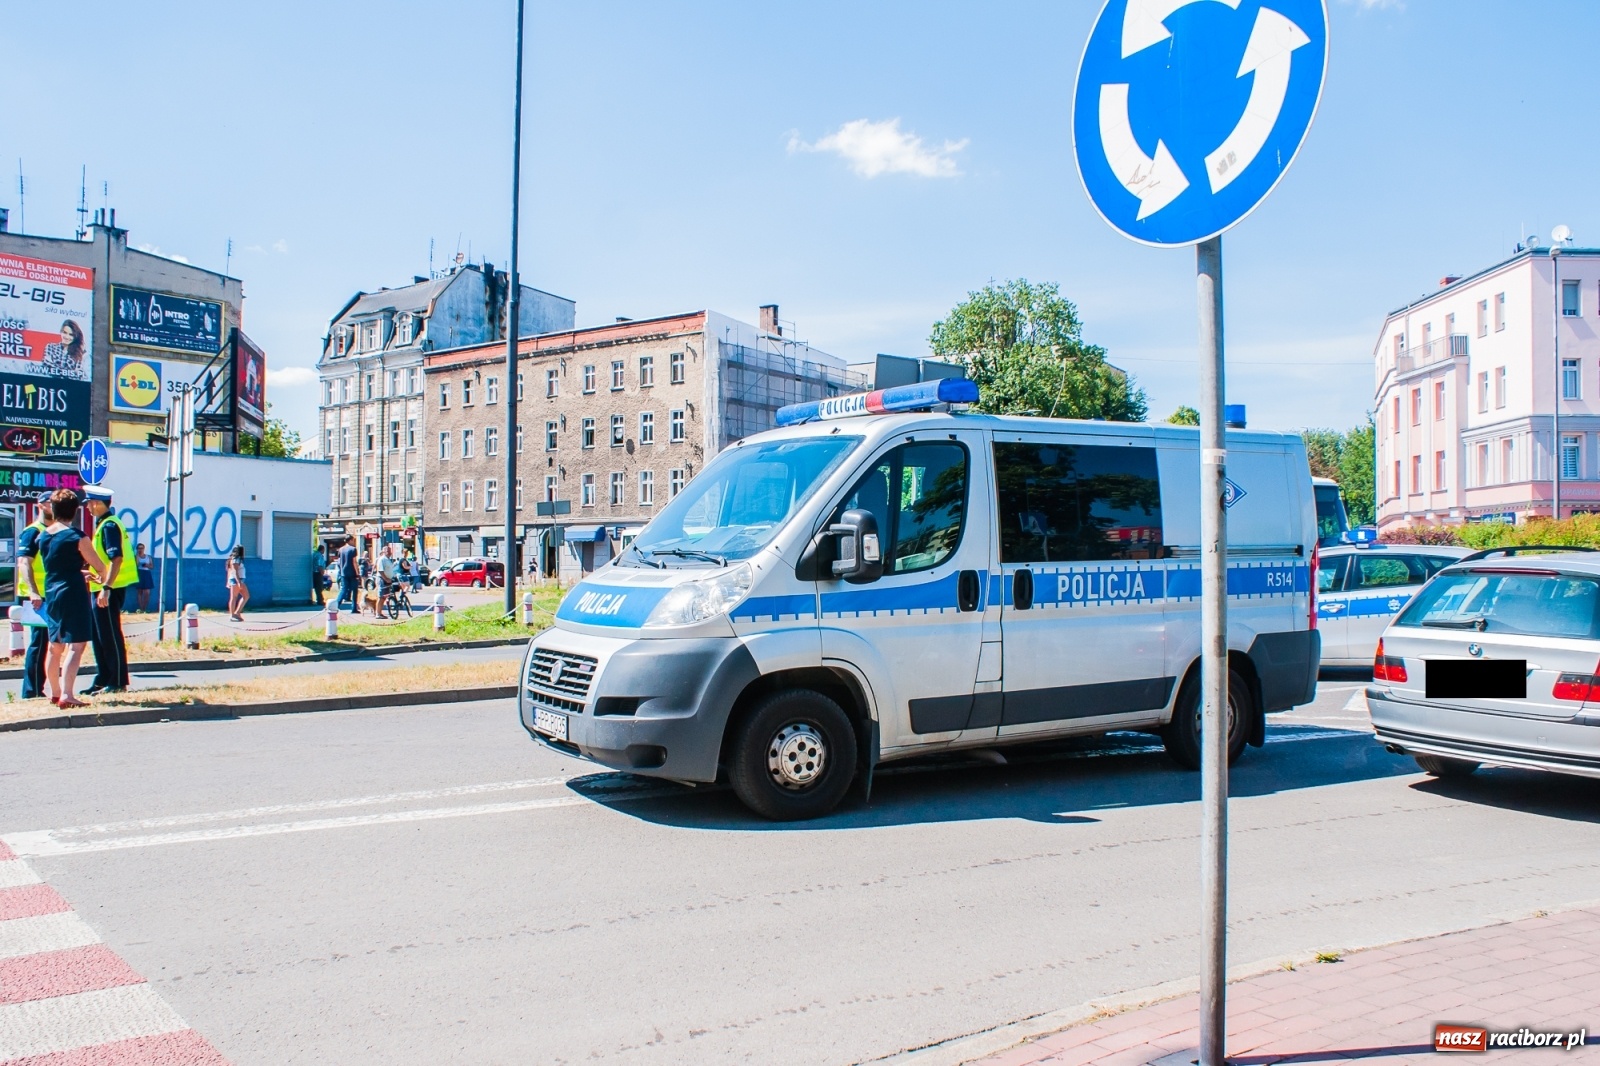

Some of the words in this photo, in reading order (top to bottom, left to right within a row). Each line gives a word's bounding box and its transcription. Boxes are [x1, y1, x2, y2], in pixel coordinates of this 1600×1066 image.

[26, 262, 87, 279] ELEKTRYCZNA
[29, 272, 68, 284] ODSŁONIE
[164, 310, 190, 320] INTRO
[118, 331, 139, 341] 12-13
[140, 333, 159, 344] lipca
[820, 395, 865, 416] POLICJA
[5, 415, 44, 425] NAJWIĘKSZY
[44, 418, 67, 427] WYBÓR
[13, 471, 31, 487] CO
[1057, 573, 1145, 601] POLICJA
[1267, 572, 1293, 587] R514
[574, 591, 628, 616] POLICJA
